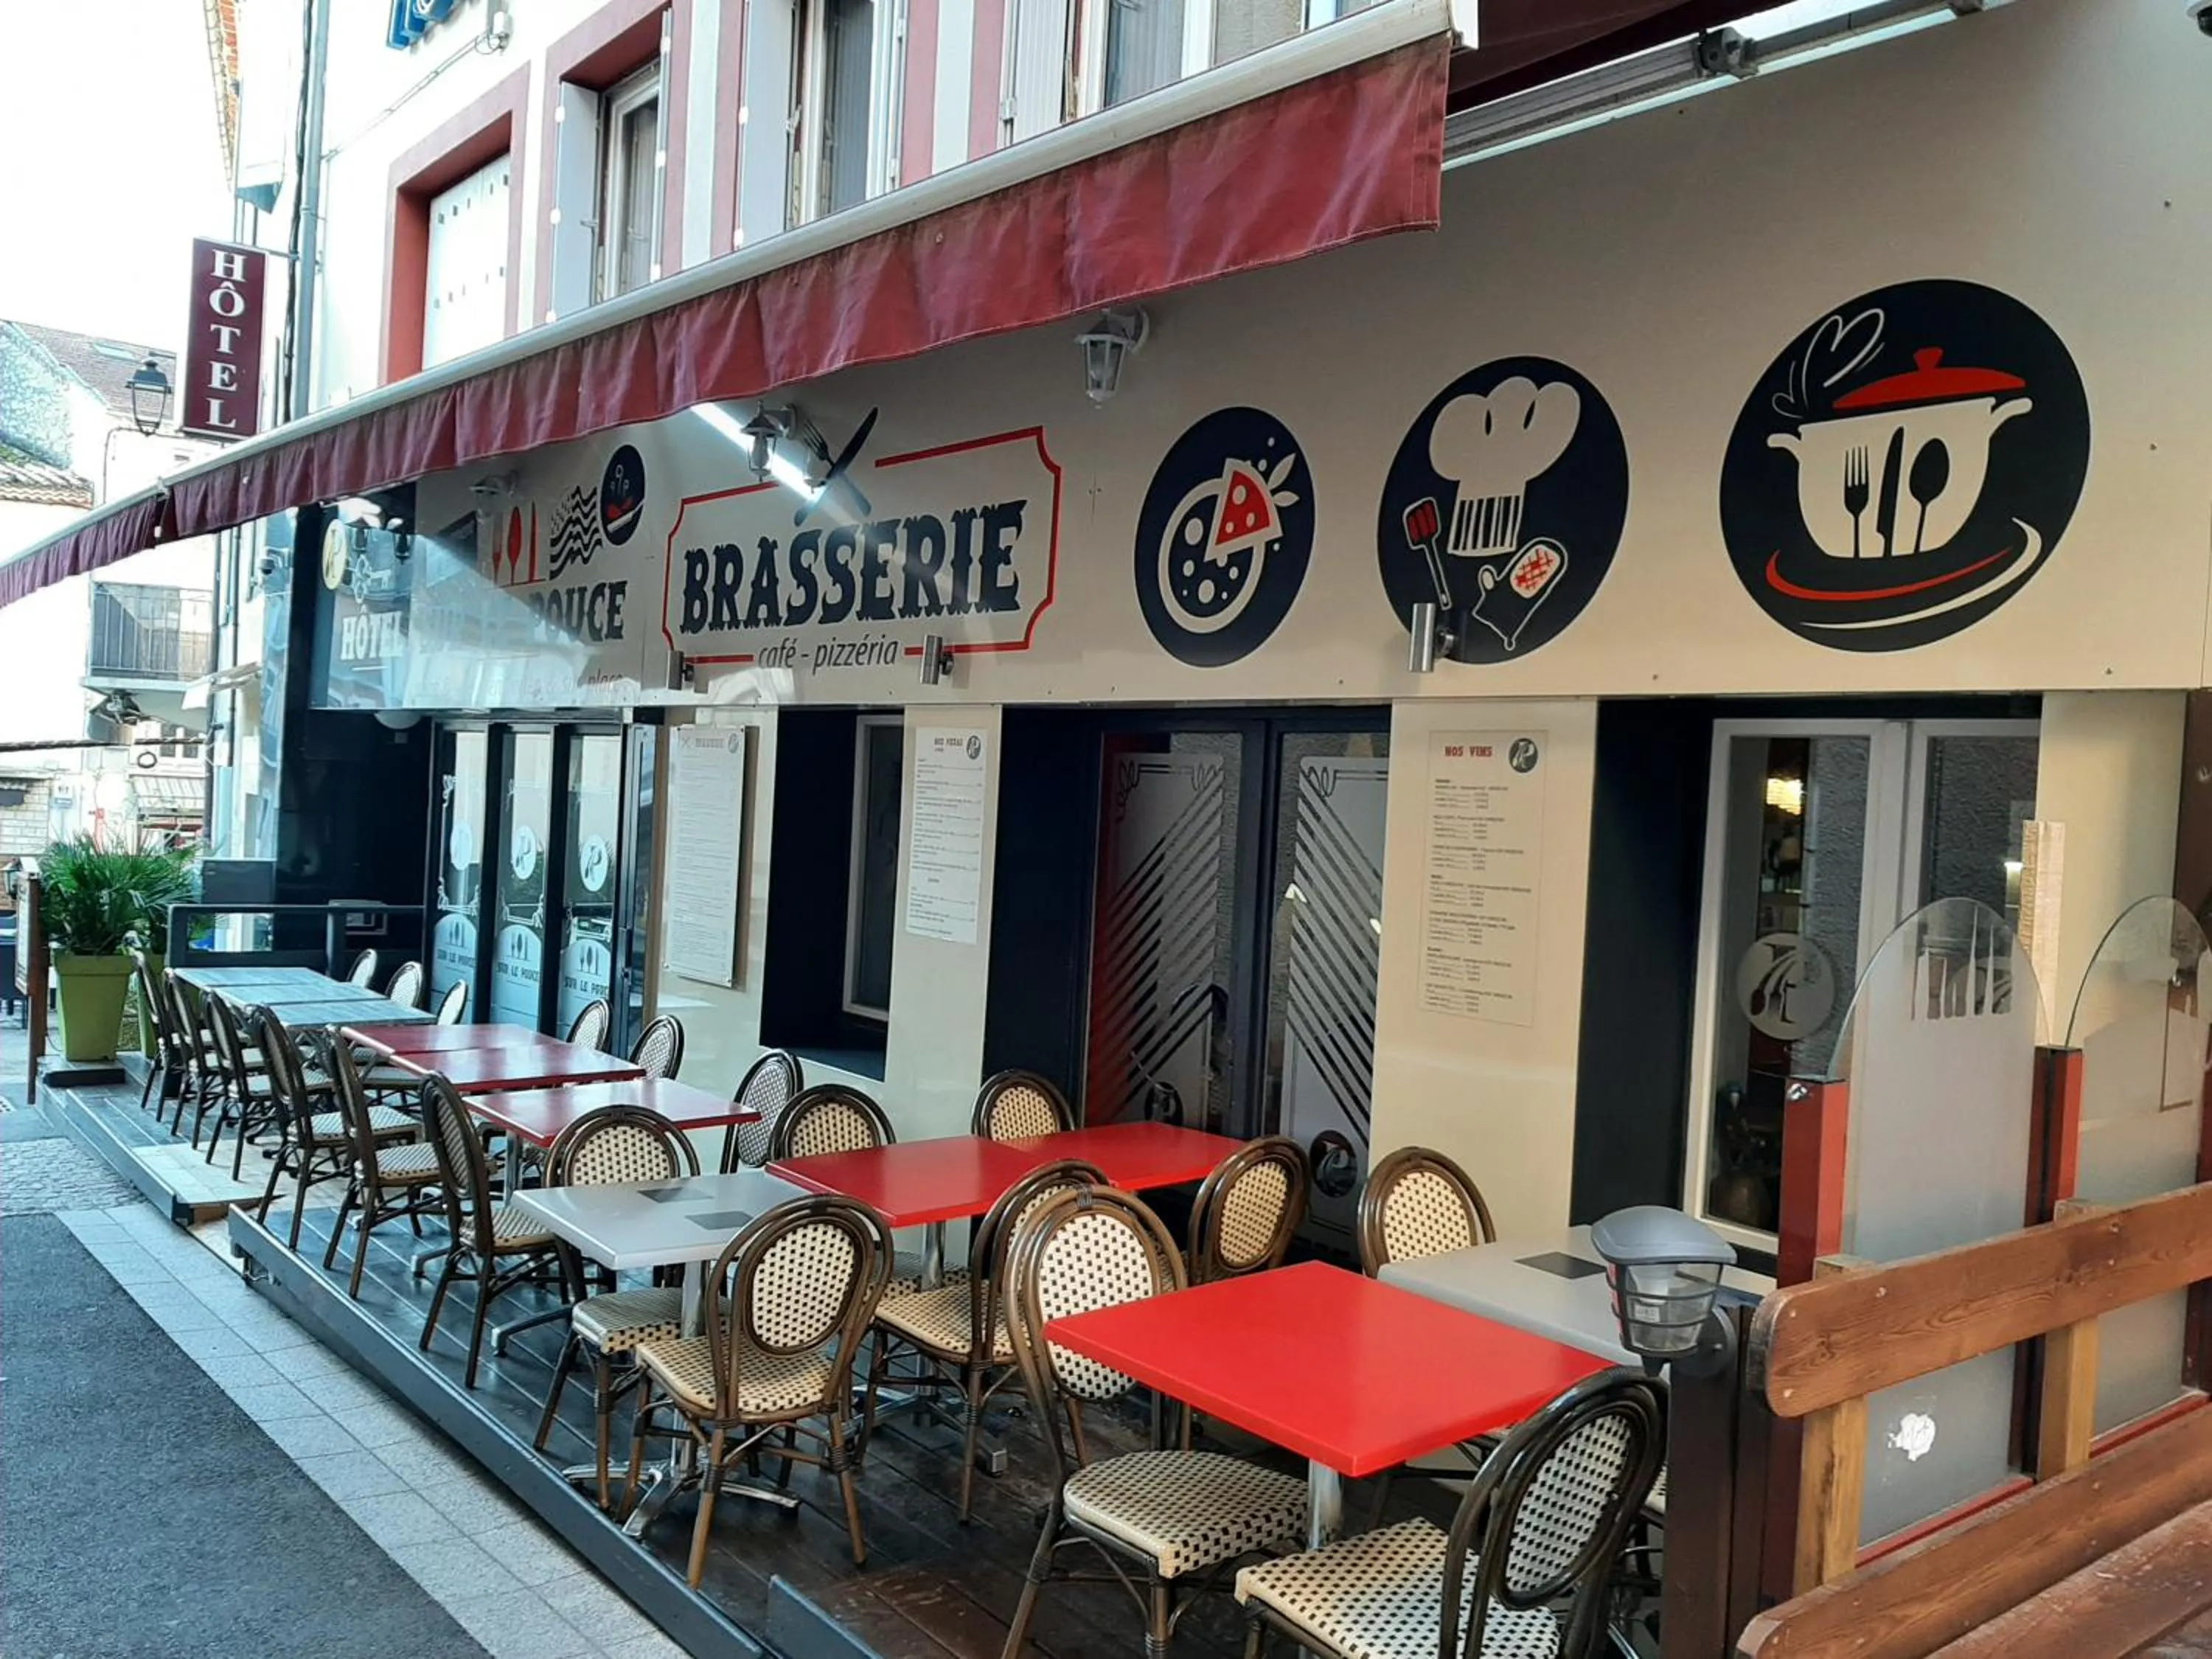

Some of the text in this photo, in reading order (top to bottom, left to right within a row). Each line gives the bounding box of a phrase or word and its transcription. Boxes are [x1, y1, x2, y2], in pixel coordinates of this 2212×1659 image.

[206, 248, 247, 429] HÔTEL
[679, 499, 1027, 634] BRASSERIE
[341, 605, 403, 660] HÔTEL
[759, 636, 797, 668] café
[812, 633, 899, 675] pizzéria
[1445, 745, 1493, 757] NOS VINS
